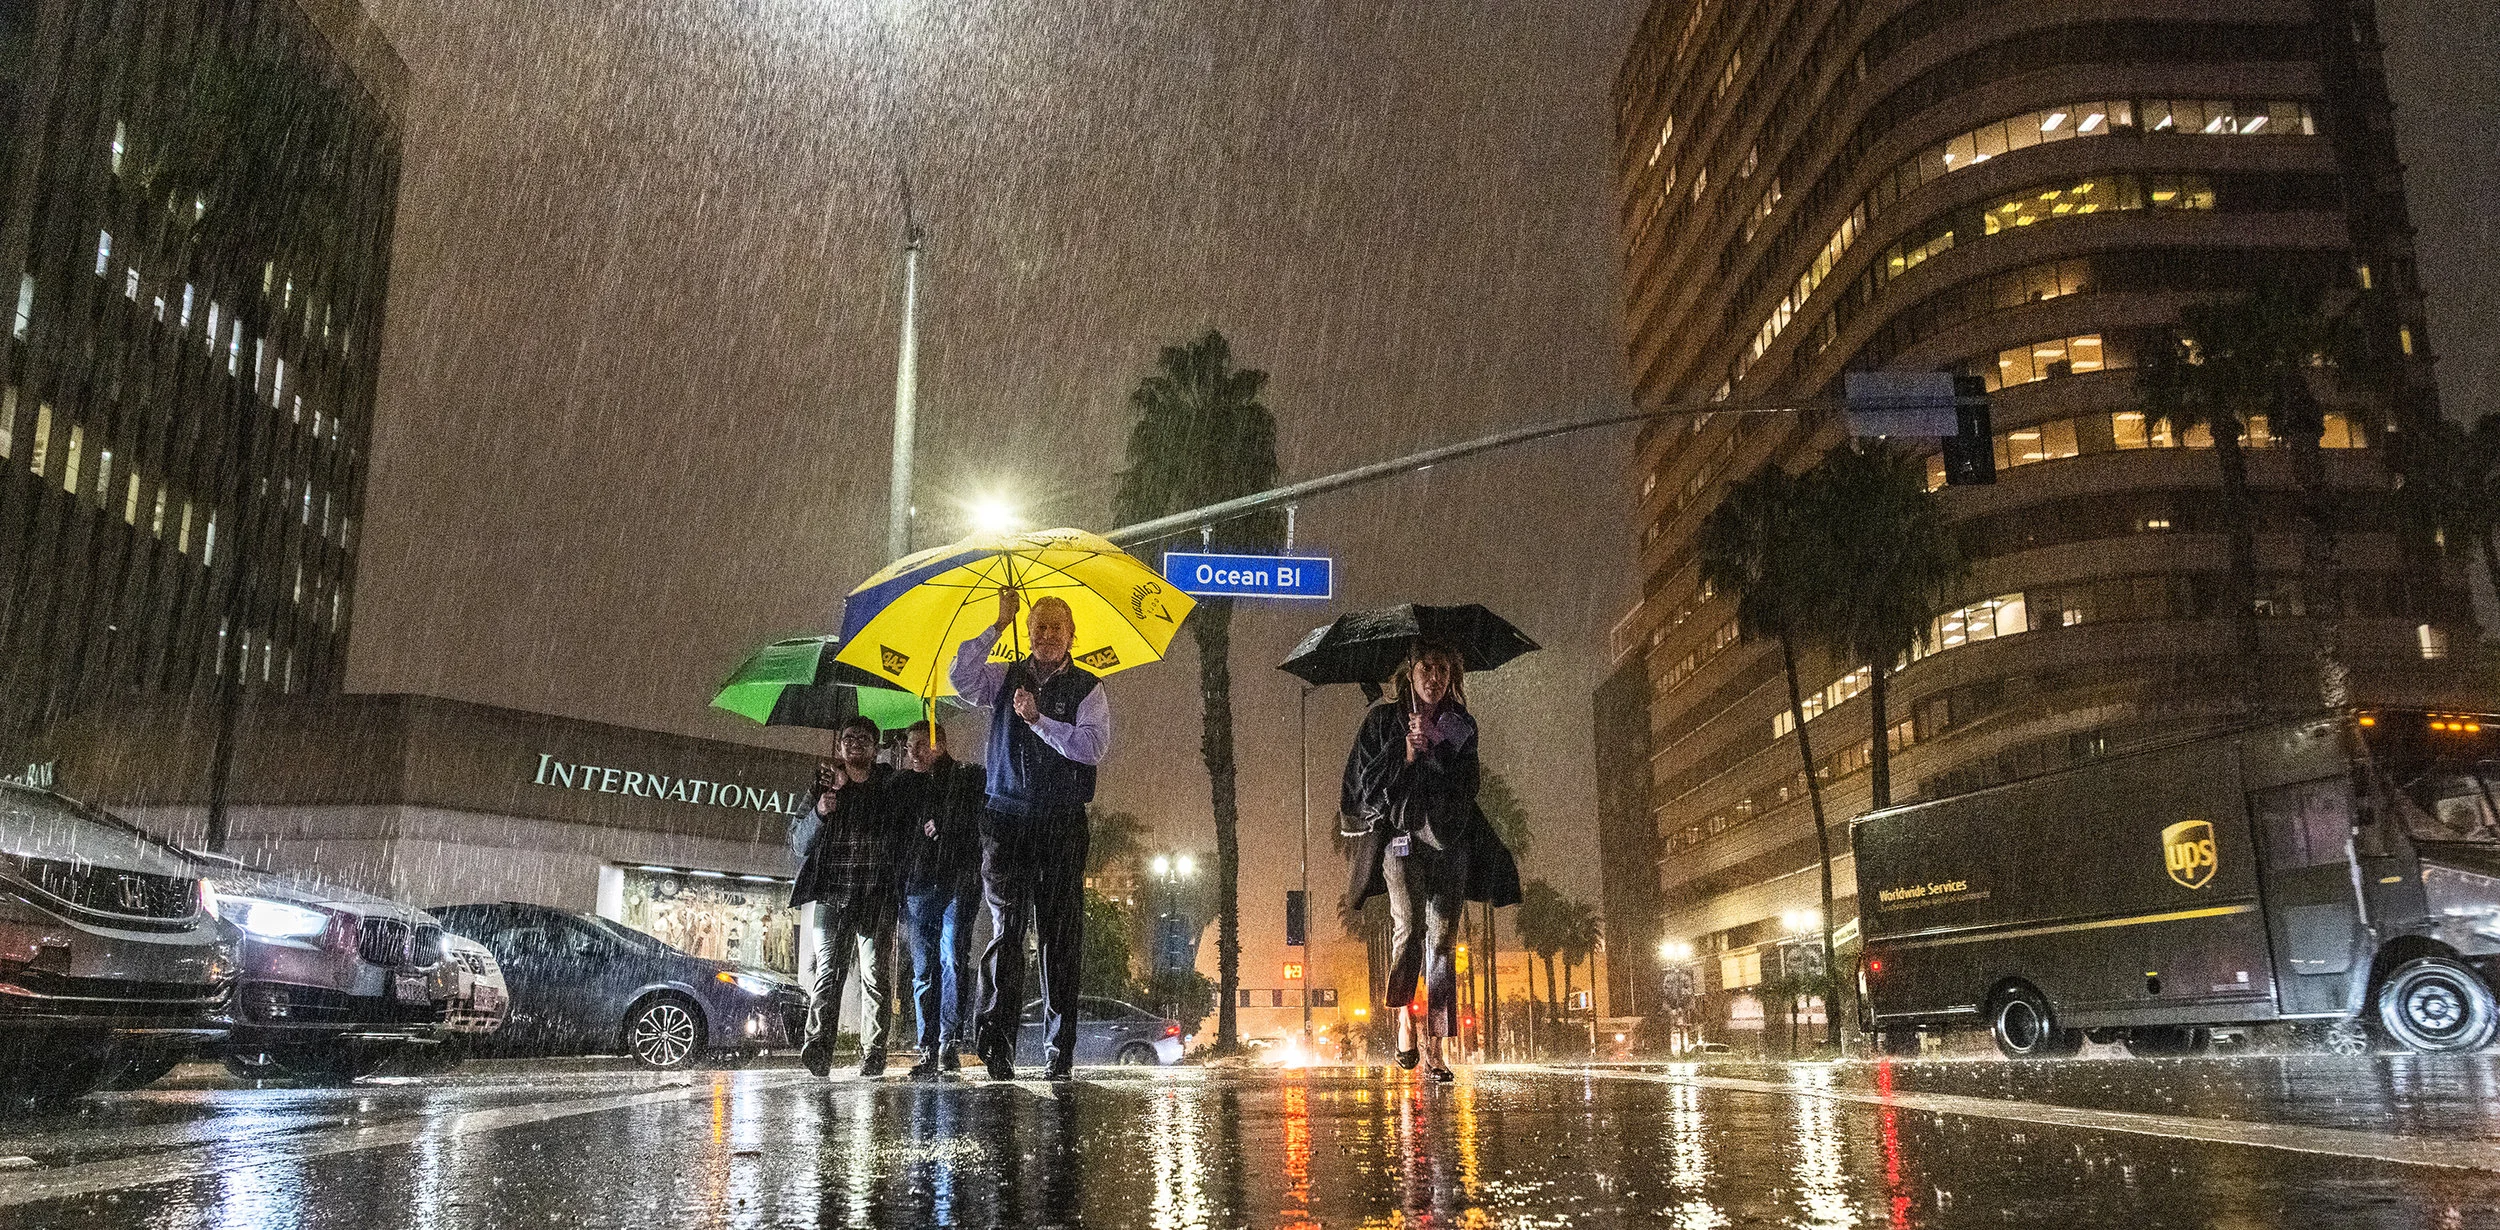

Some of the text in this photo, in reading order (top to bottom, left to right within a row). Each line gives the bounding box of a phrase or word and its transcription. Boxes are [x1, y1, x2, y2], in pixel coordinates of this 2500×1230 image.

[1195, 563, 1301, 588] Ocean Bl
[2168, 839, 2214, 879] ups
[1879, 884, 1926, 902] Worldwide
[1927, 879, 1968, 896] Services
